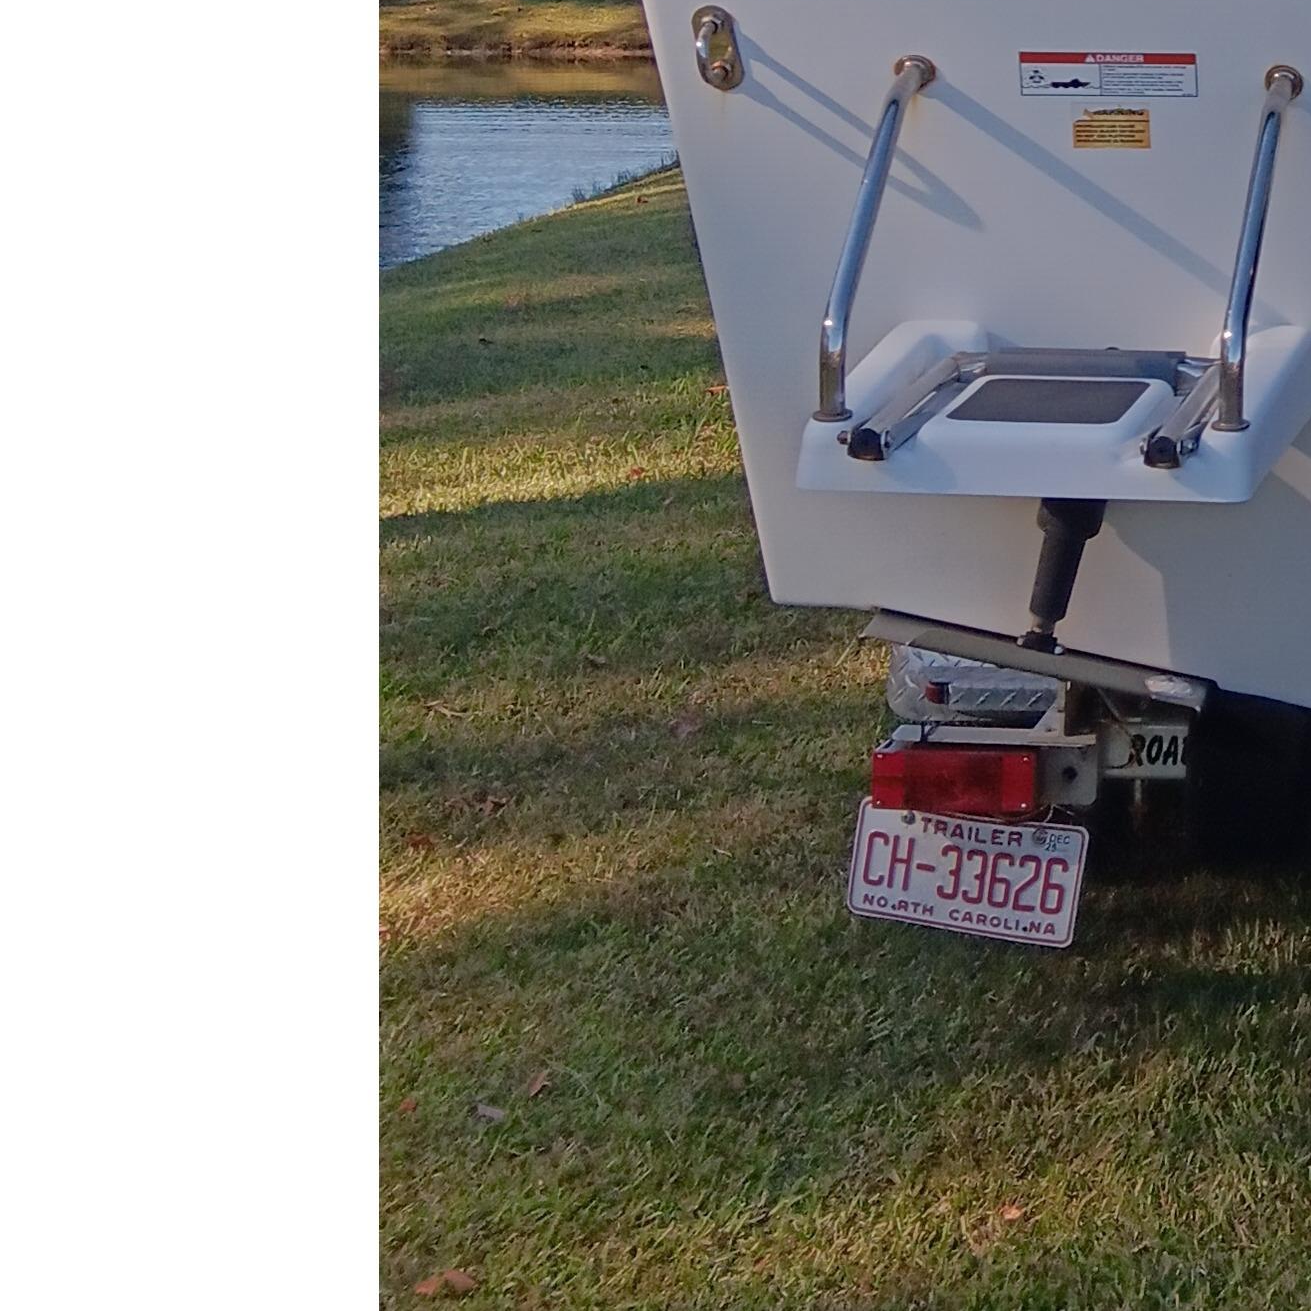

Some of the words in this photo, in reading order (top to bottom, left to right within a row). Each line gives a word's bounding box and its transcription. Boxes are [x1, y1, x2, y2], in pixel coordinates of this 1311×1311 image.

[1096, 54, 1144, 63] DANGER
[920, 816, 1024, 847] TRAILER
[1049, 833, 1071, 845] DEC
[862, 830, 1070, 916] CH-33626
[862, 892, 934, 916] NORTH
[948, 908, 1056, 936] CAROLINA
